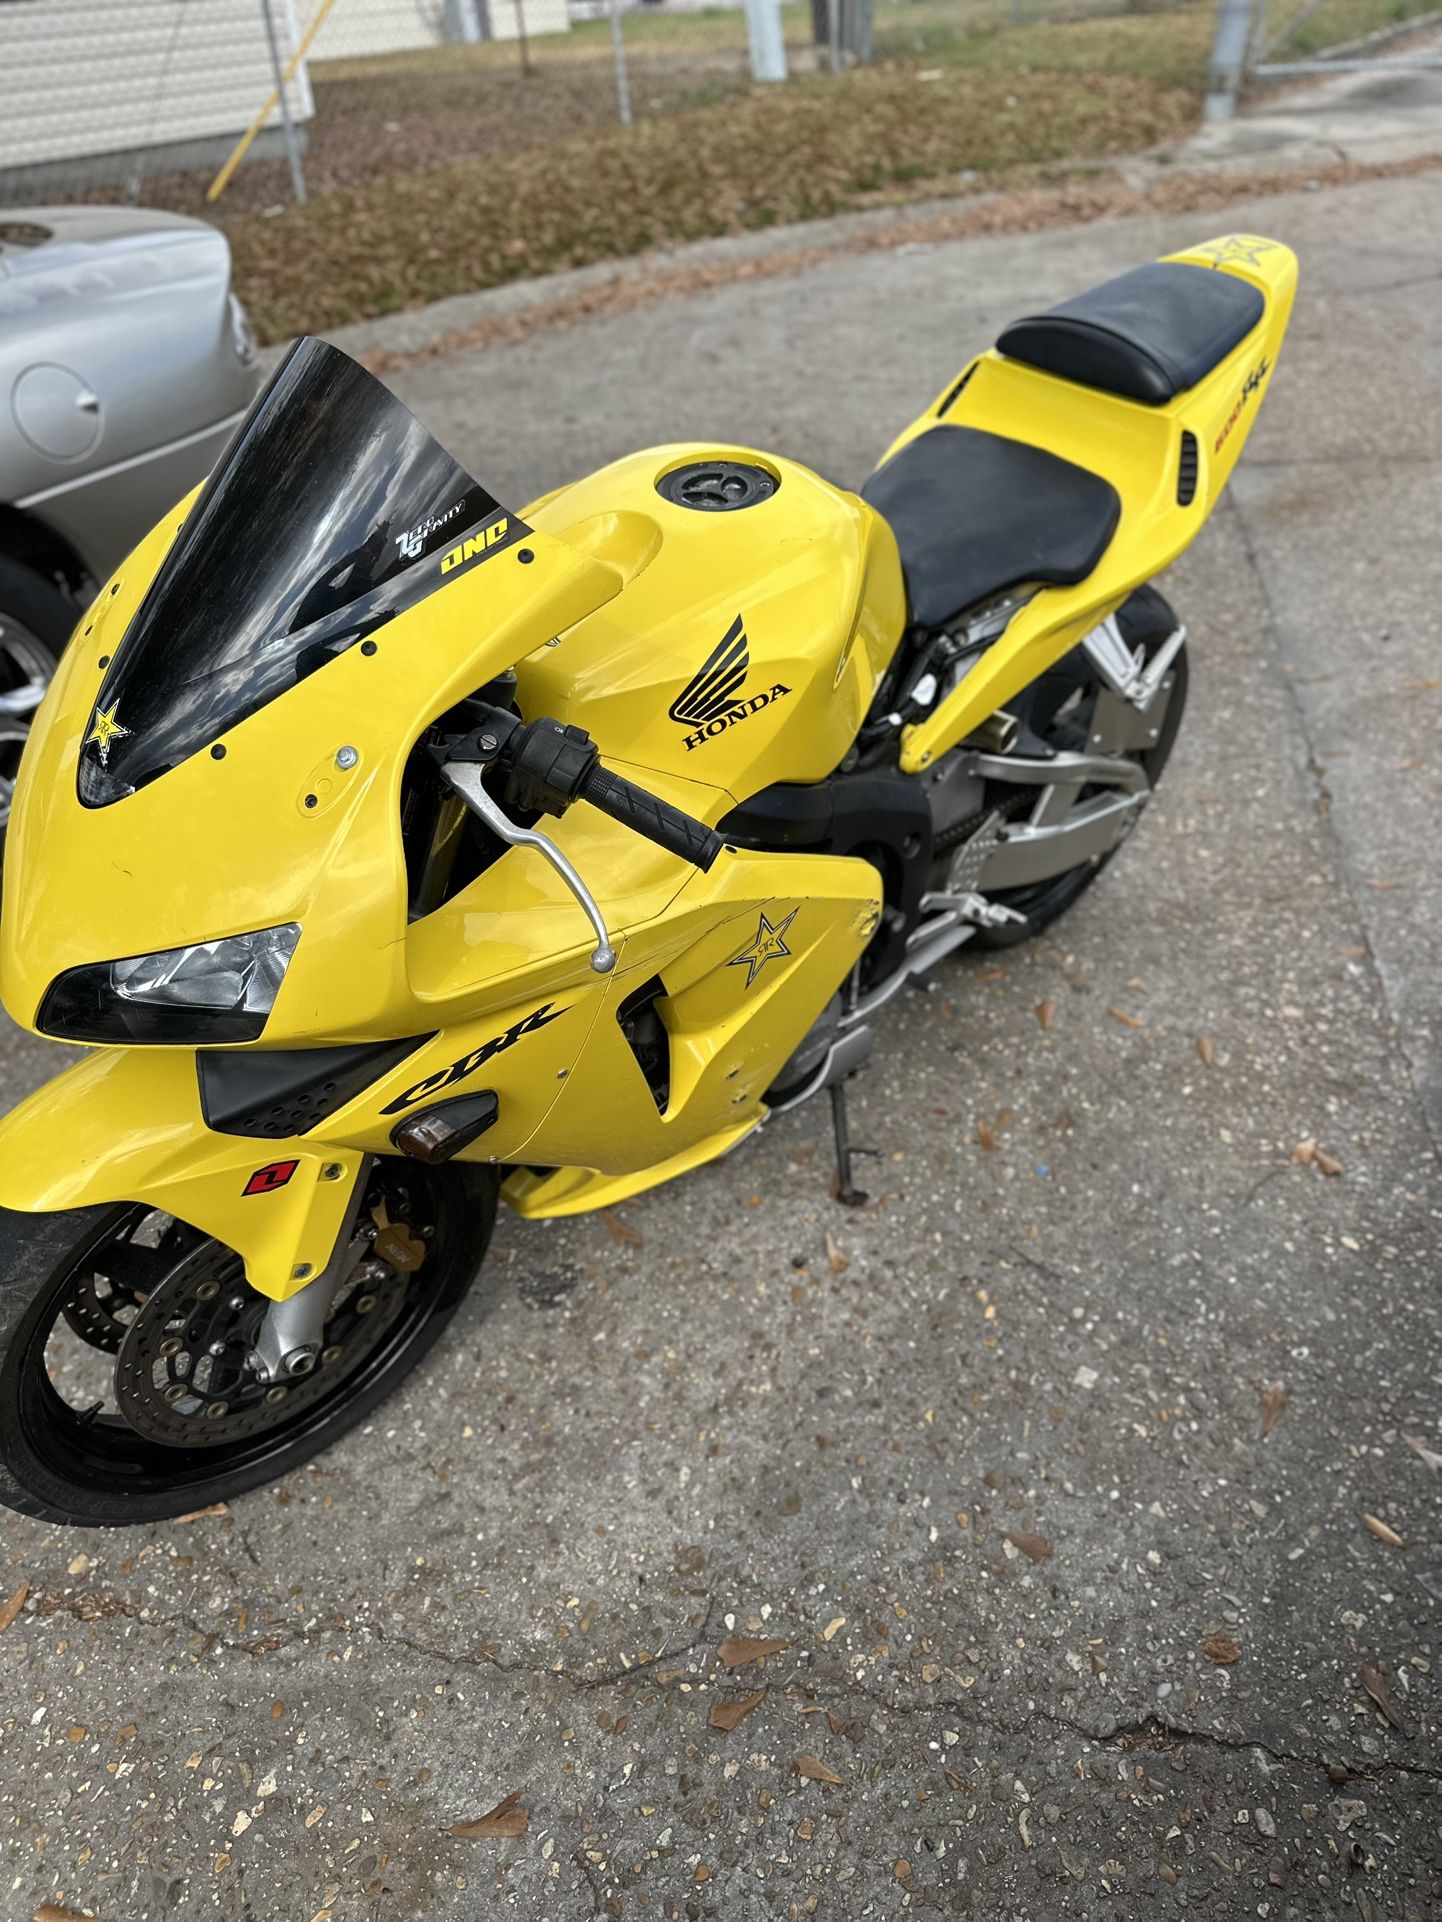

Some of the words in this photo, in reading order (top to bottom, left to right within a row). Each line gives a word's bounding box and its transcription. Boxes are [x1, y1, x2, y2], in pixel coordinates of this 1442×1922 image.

[396, 516, 435, 558] ZERO
[682, 683, 793, 752] HONDA
[378, 1001, 576, 1114] CBR
